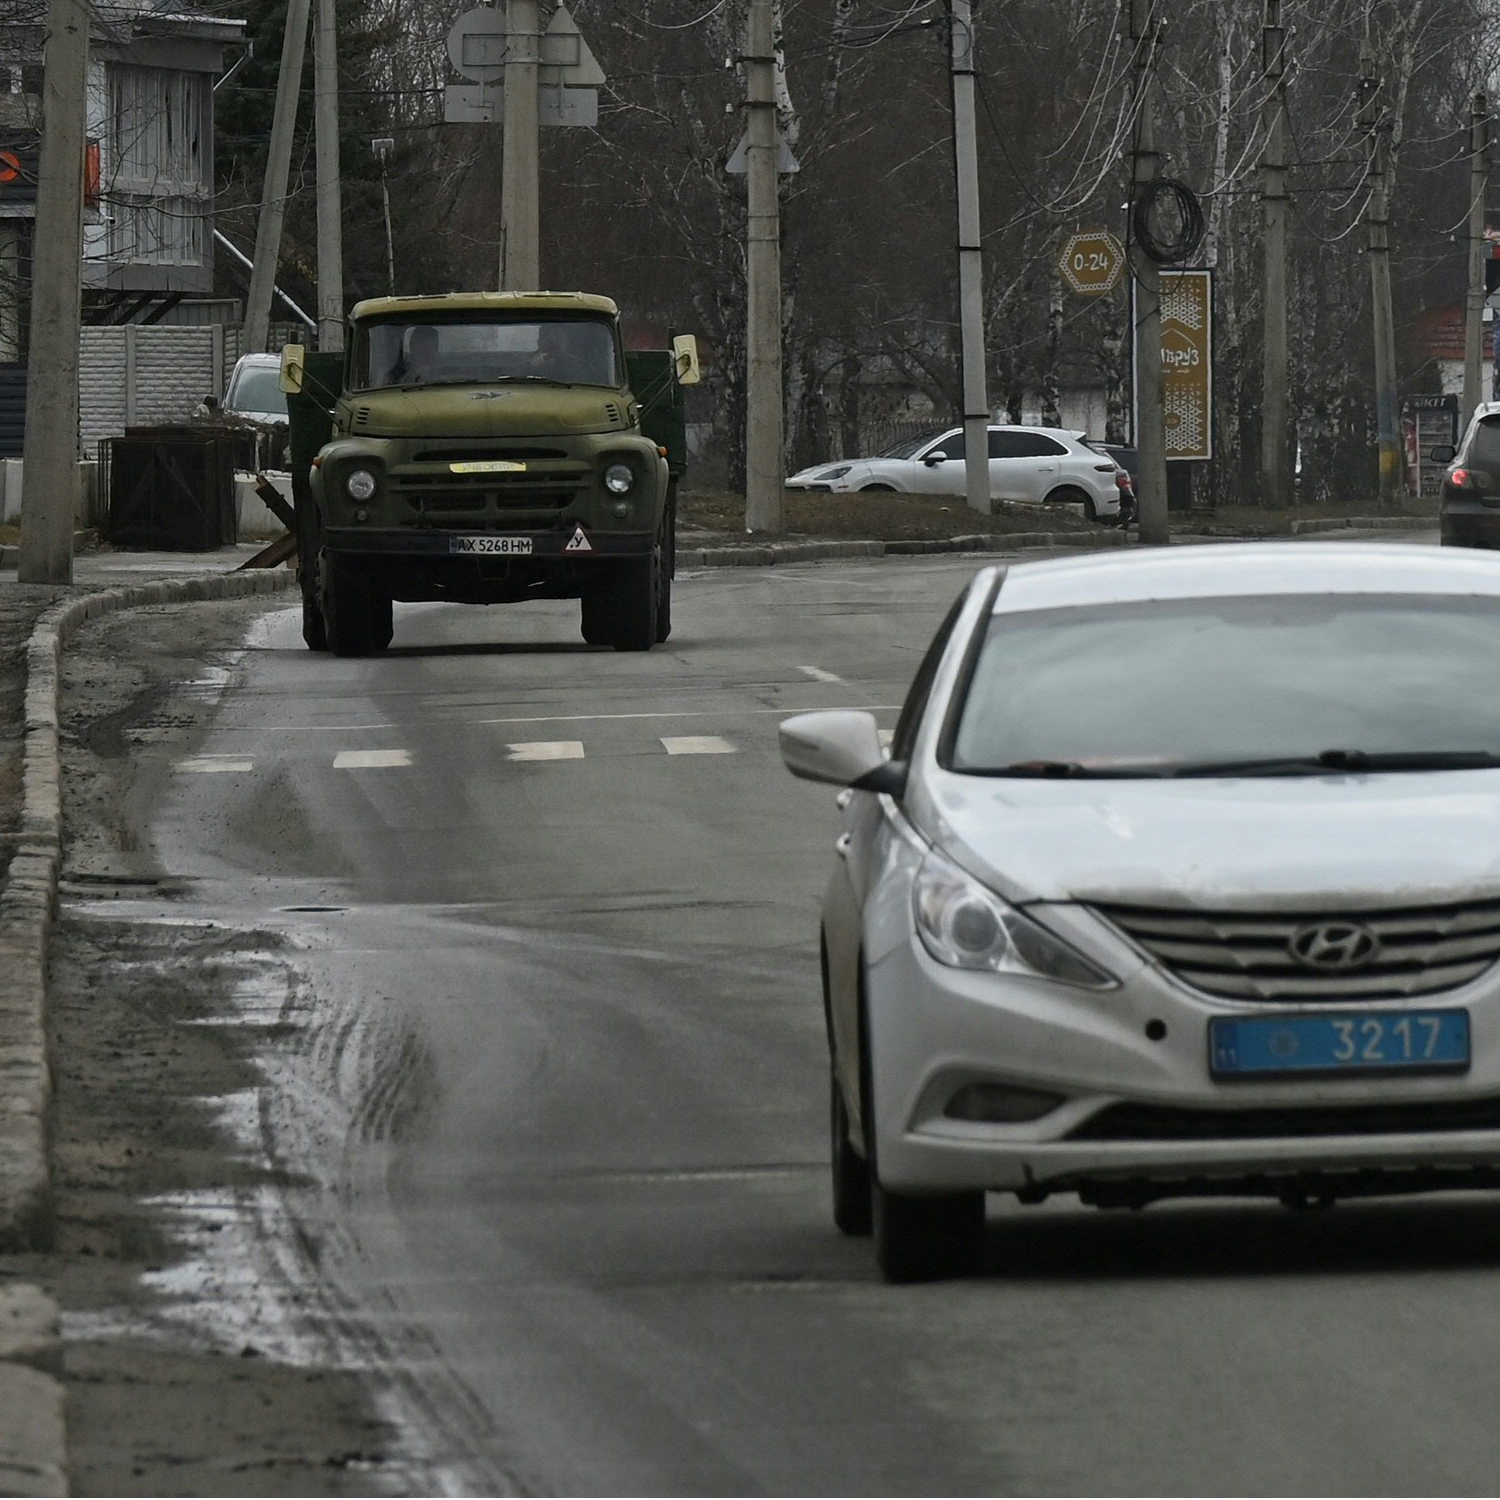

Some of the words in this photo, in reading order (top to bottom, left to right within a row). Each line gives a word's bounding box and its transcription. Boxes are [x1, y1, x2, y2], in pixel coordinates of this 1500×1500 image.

[1073, 253, 1109, 271] 0-24
[457, 539, 476, 552] AX
[479, 539, 509, 552] 5268
[511, 540, 531, 552] HM
[1331, 1017, 1441, 1061] 3217
